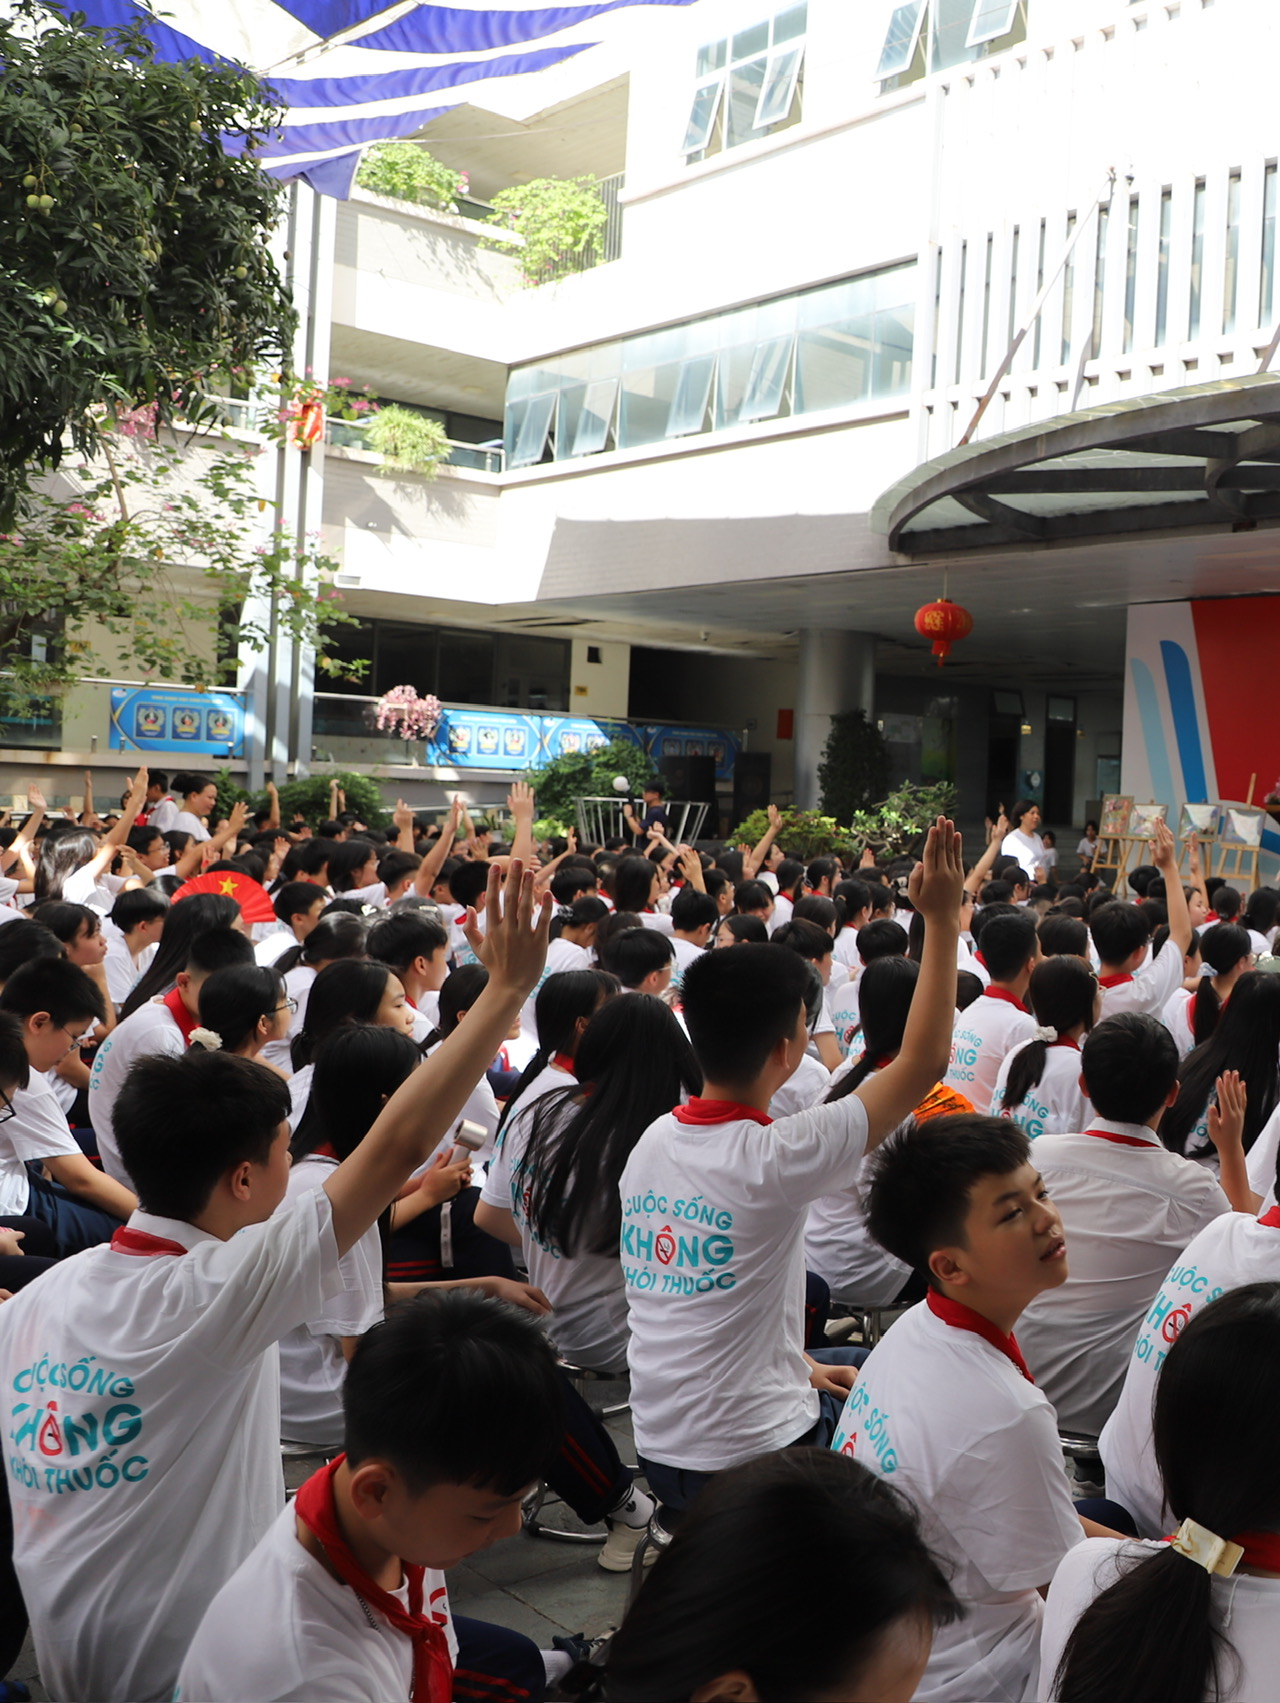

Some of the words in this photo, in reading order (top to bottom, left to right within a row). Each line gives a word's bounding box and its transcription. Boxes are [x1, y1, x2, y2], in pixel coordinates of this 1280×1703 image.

[1023, 1091, 1049, 1119] ỐNG
[624, 1189, 668, 1219] CUỘC
[672, 1195, 733, 1231] SỐNG
[620, 1222, 734, 1268] KHÔNG
[623, 1265, 657, 1291] HÓI
[661, 1268, 737, 1296] THUỐC
[10, 1401, 143, 1457] HÔNG
[44, 1449, 149, 1494] THUỐC
